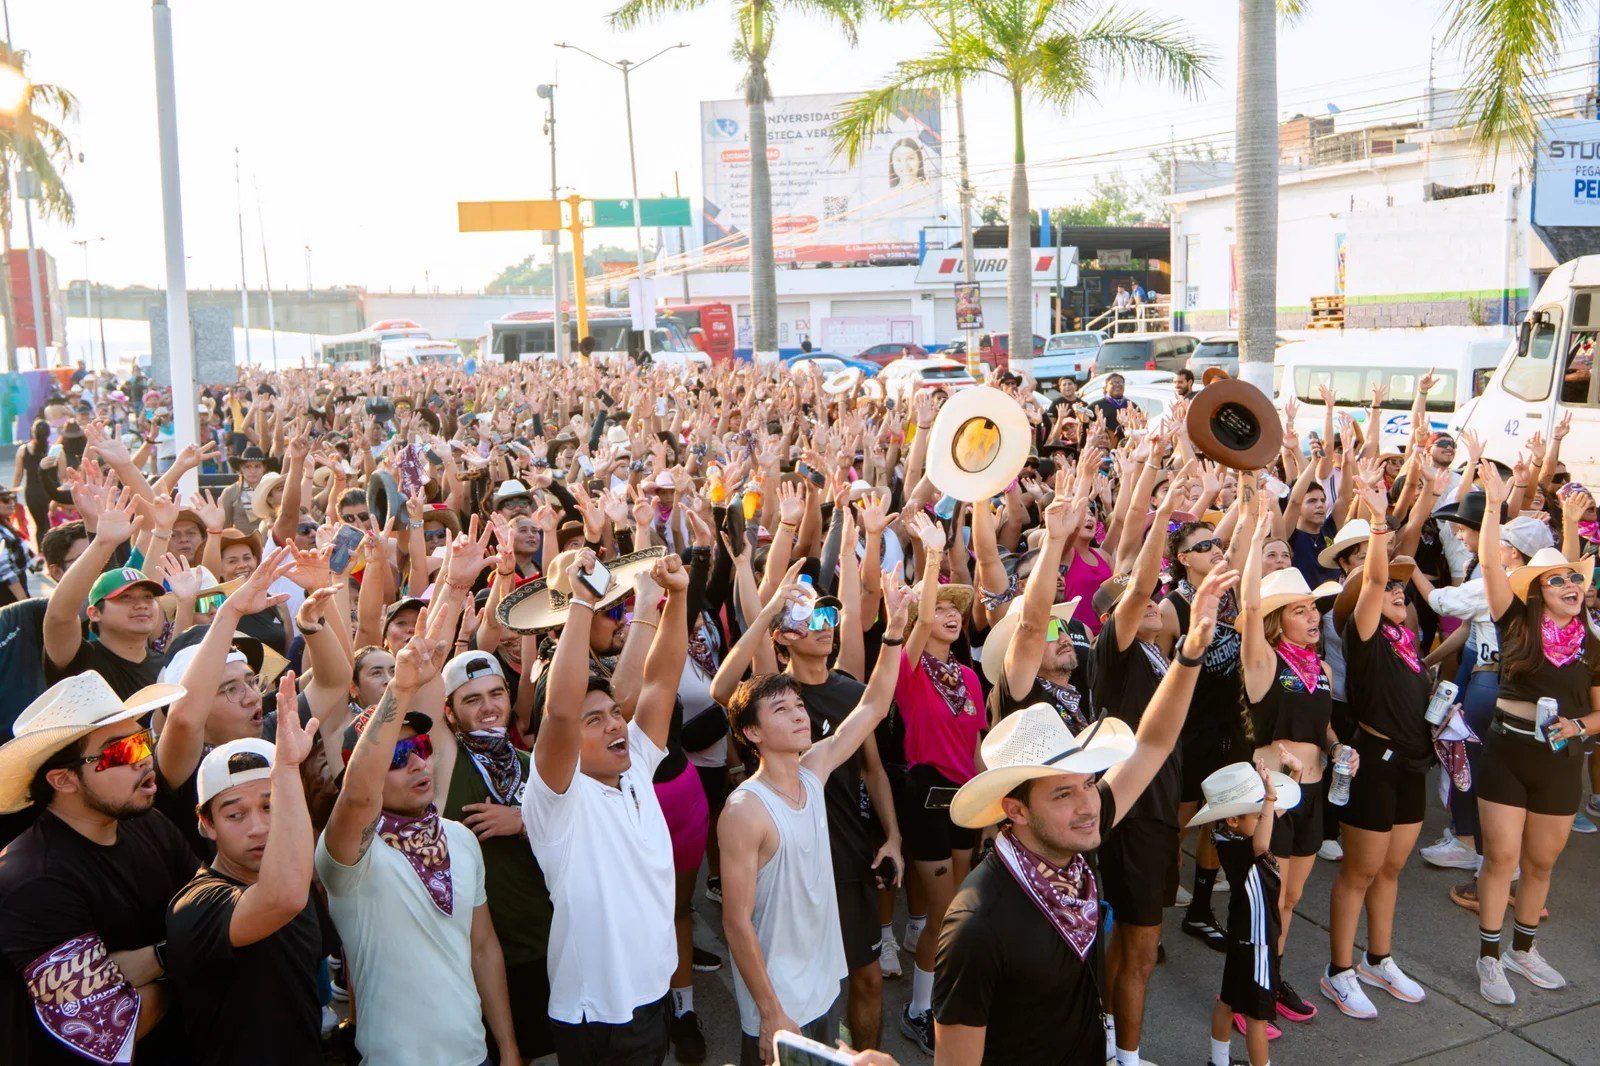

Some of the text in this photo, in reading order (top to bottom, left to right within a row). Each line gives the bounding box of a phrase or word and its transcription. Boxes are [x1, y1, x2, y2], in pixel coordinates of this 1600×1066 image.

[764, 112, 839, 125] NIVERSIDAD
[1549, 140, 1600, 159] STU
[1574, 179, 1600, 198] PE
[956, 259, 1008, 273] UNIRO
[1504, 418, 1520, 436] 42
